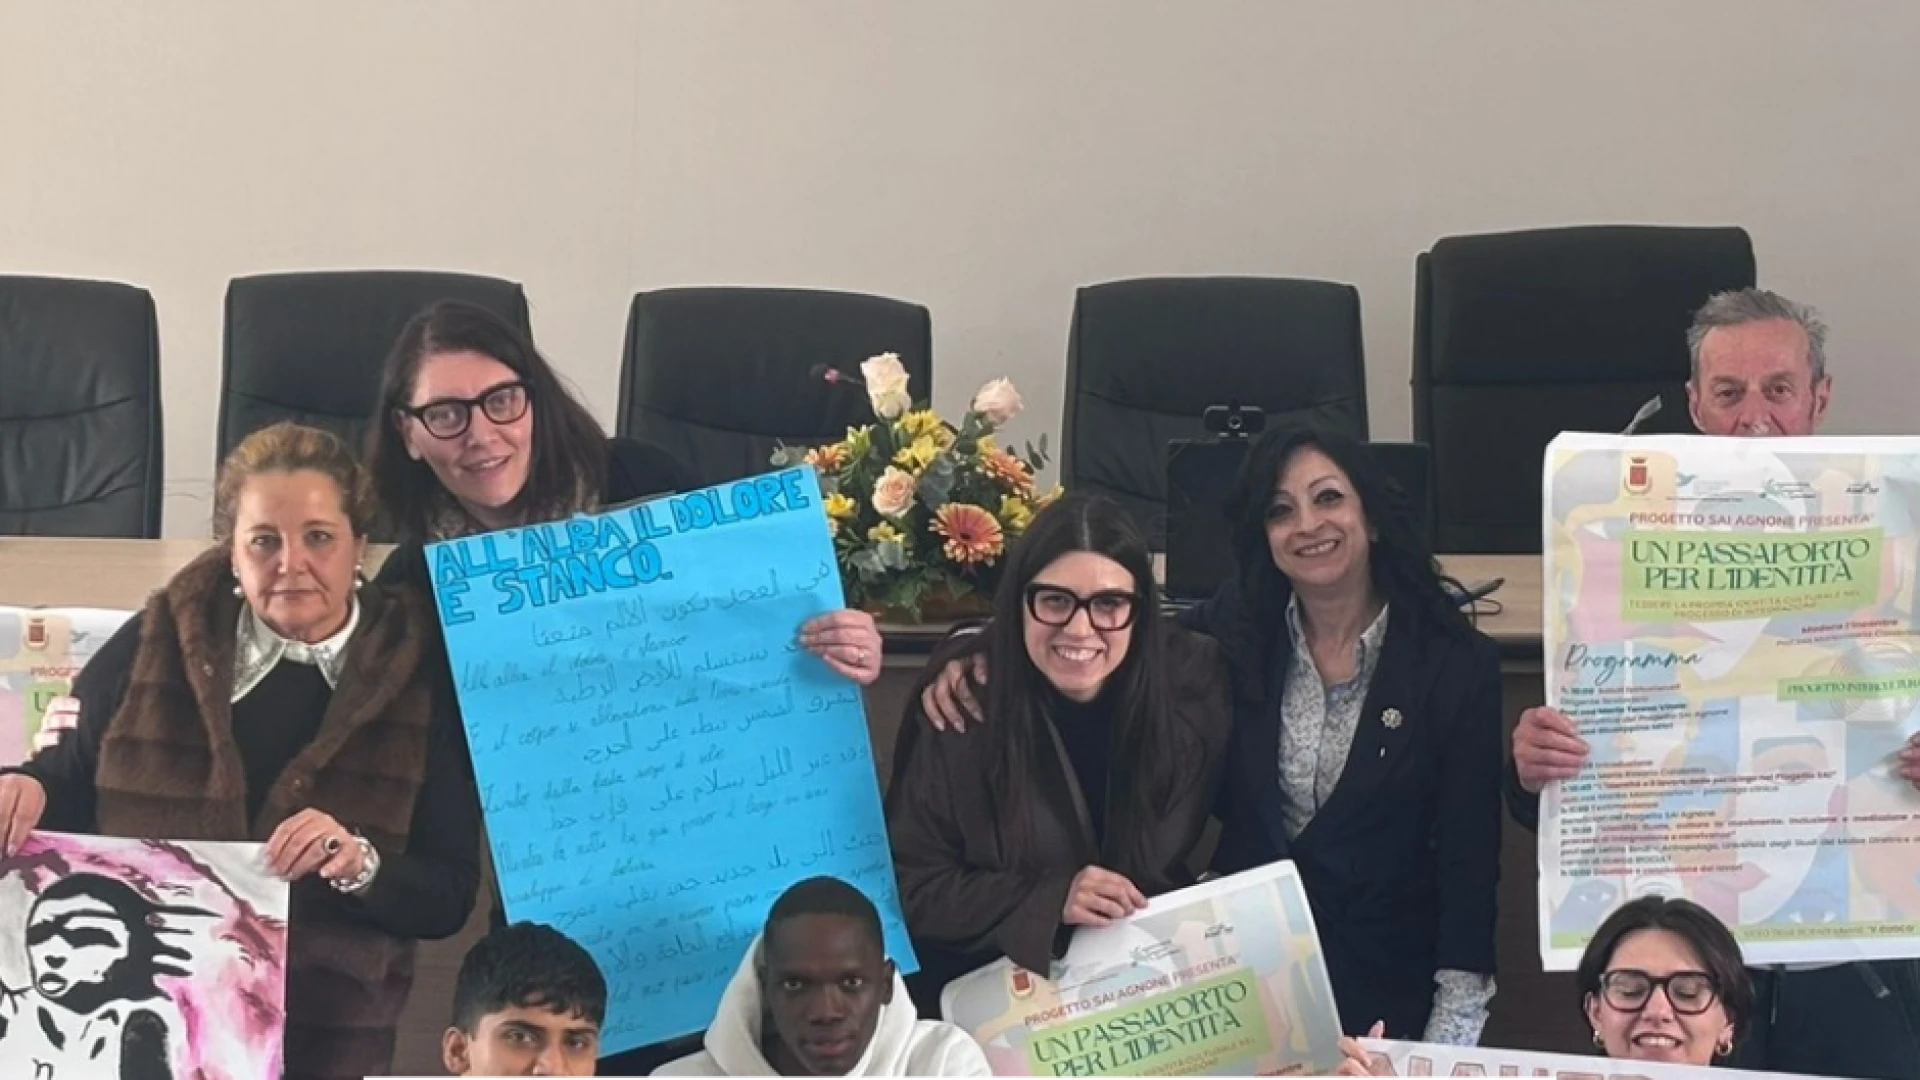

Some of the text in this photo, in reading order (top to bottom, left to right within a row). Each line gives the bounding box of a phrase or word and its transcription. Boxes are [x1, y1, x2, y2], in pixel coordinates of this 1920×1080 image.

[433, 469, 809, 584] ALL'ALBA IL DOLORE
[1629, 512, 1704, 526] PROGETTO
[1708, 513, 1731, 526] SAI
[1734, 514, 1795, 529] AGNONE
[1631, 536, 1871, 566] UN PASSAPORTO
[496, 542, 673, 615] STANCO.
[1644, 566, 1701, 590] PER
[1564, 643, 1702, 687] Programma
[1024, 999, 1092, 1026] PROGETTO
[1092, 990, 1115, 1009] SAI
[1115, 972, 1170, 1002] AGNONE
[1033, 1033, 1071, 1063] UN
[1073, 979, 1247, 1049] PASSAPORTO
[1051, 1049, 1107, 1076] PER
